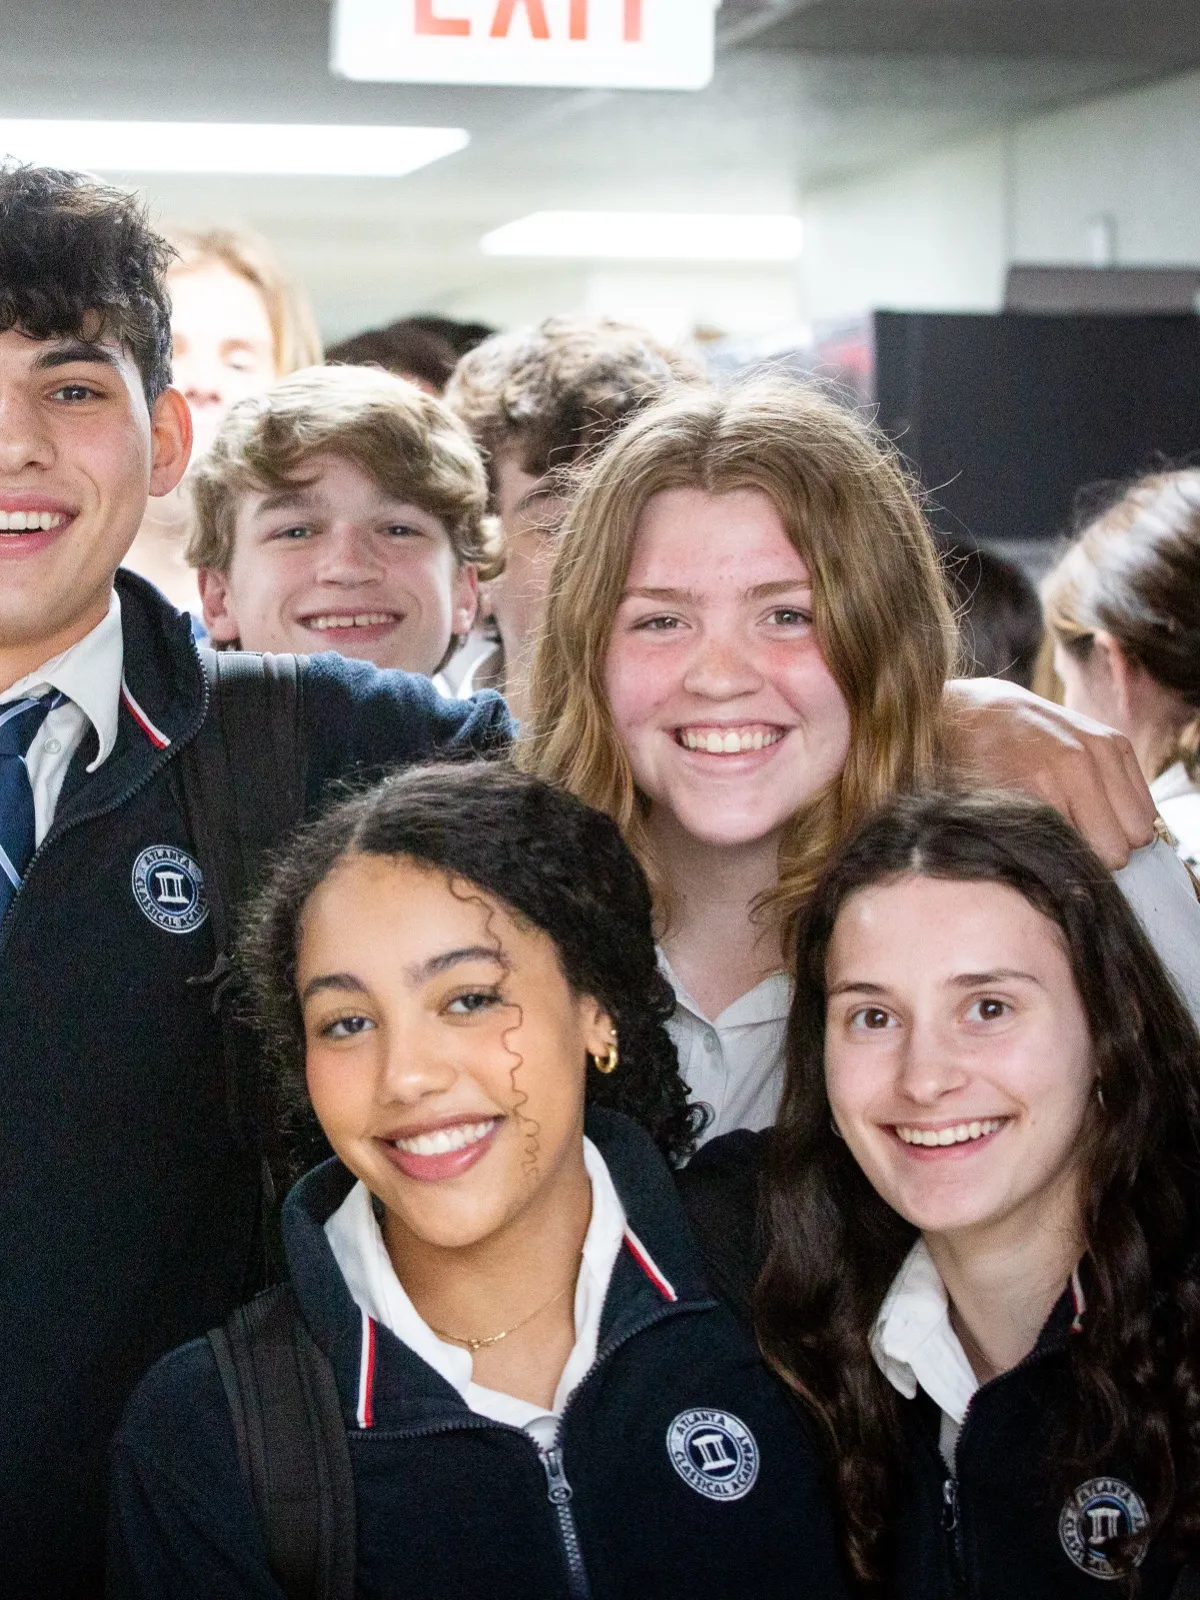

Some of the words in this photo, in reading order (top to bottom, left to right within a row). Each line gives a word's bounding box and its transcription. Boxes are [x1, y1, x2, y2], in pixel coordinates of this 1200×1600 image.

[144, 850, 190, 869] ATLANTA
[136, 877, 176, 926] CLASSICAL
[676, 1412, 725, 1435] ATLANTA
[674, 1451, 729, 1494] CLASSICAL
[731, 1436, 754, 1489] ACADEMY
